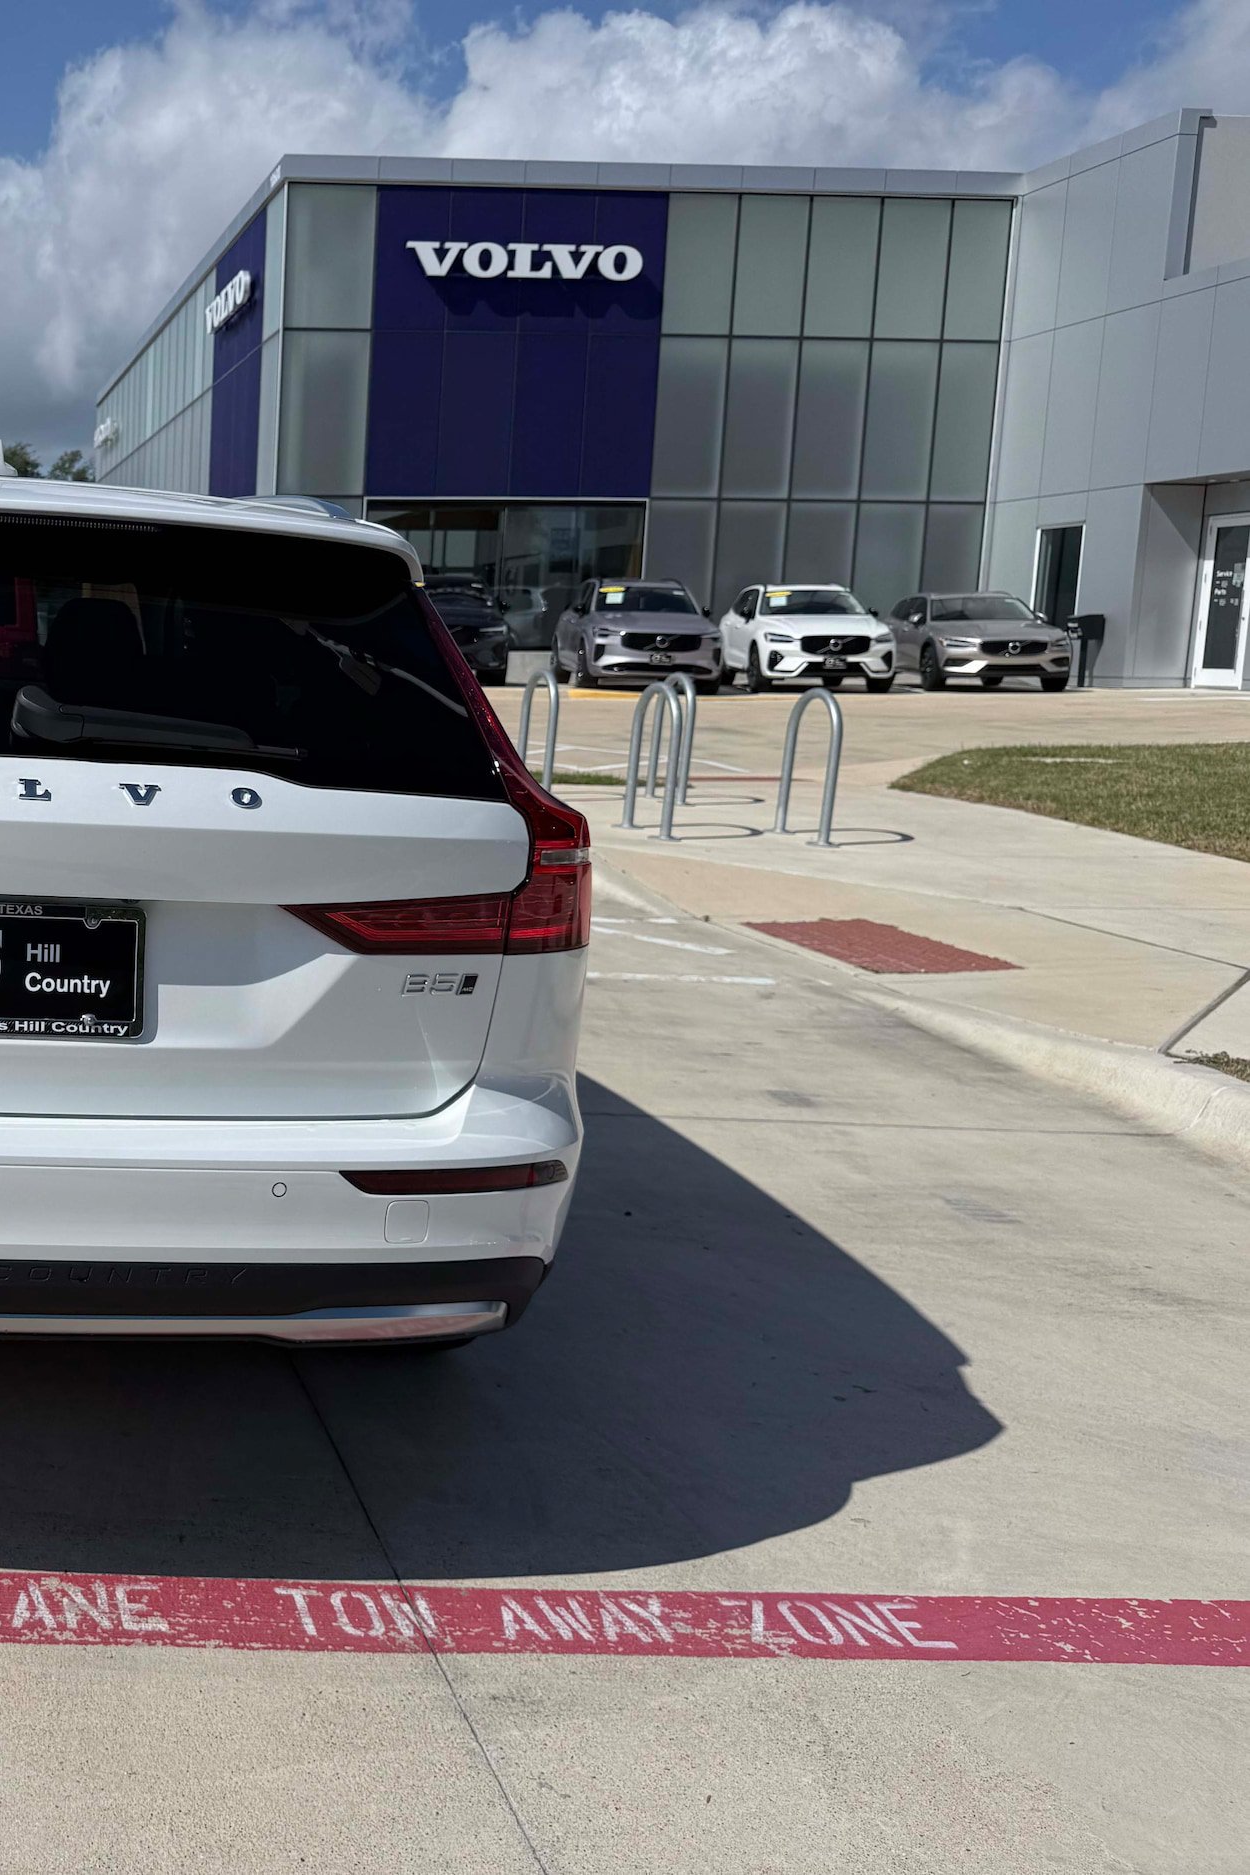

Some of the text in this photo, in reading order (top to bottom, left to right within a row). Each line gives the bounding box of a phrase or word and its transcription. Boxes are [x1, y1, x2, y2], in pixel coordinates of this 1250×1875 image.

[406, 241, 643, 281] VOLVO
[205, 270, 251, 334] VOLVO
[26, 943, 61, 963] Hill
[24, 971, 111, 998] Country
[401, 973, 459, 997] B5
[14, 1021, 46, 1032] Hill
[51, 1021, 129, 1037] Country
[274, 1586, 438, 1641] TOW
[500, 1592, 675, 1643] AWAY
[716, 1597, 959, 1651] ZONE
